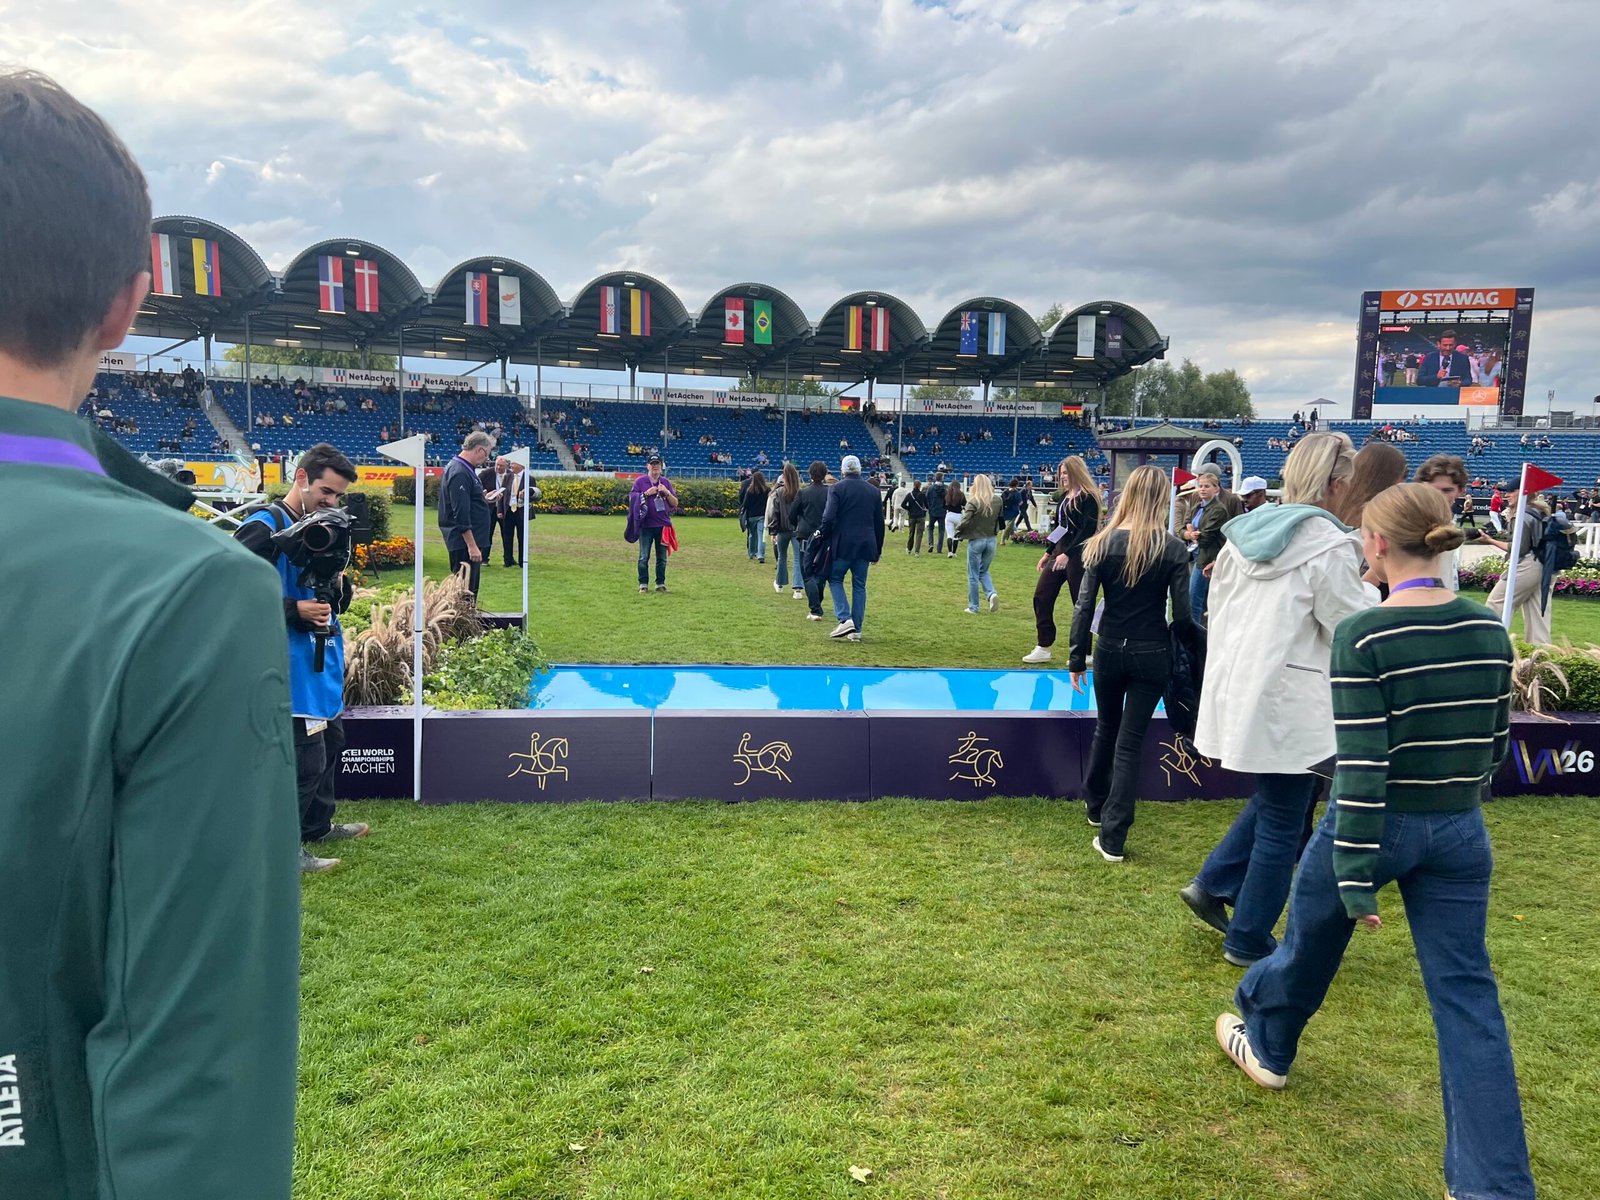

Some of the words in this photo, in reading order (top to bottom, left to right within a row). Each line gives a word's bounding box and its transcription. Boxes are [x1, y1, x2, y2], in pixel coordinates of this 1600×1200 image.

[1421, 291, 1499, 307] STAWAG
[348, 372, 396, 383] NetAachen
[424, 377, 469, 388] NetAachen
[729, 395, 767, 404] NetAachen
[935, 402, 973, 411] NetAachen
[365, 472, 398, 481] DHL
[362, 748, 394, 756] WORLD
[341, 762, 395, 774] AACHEN
